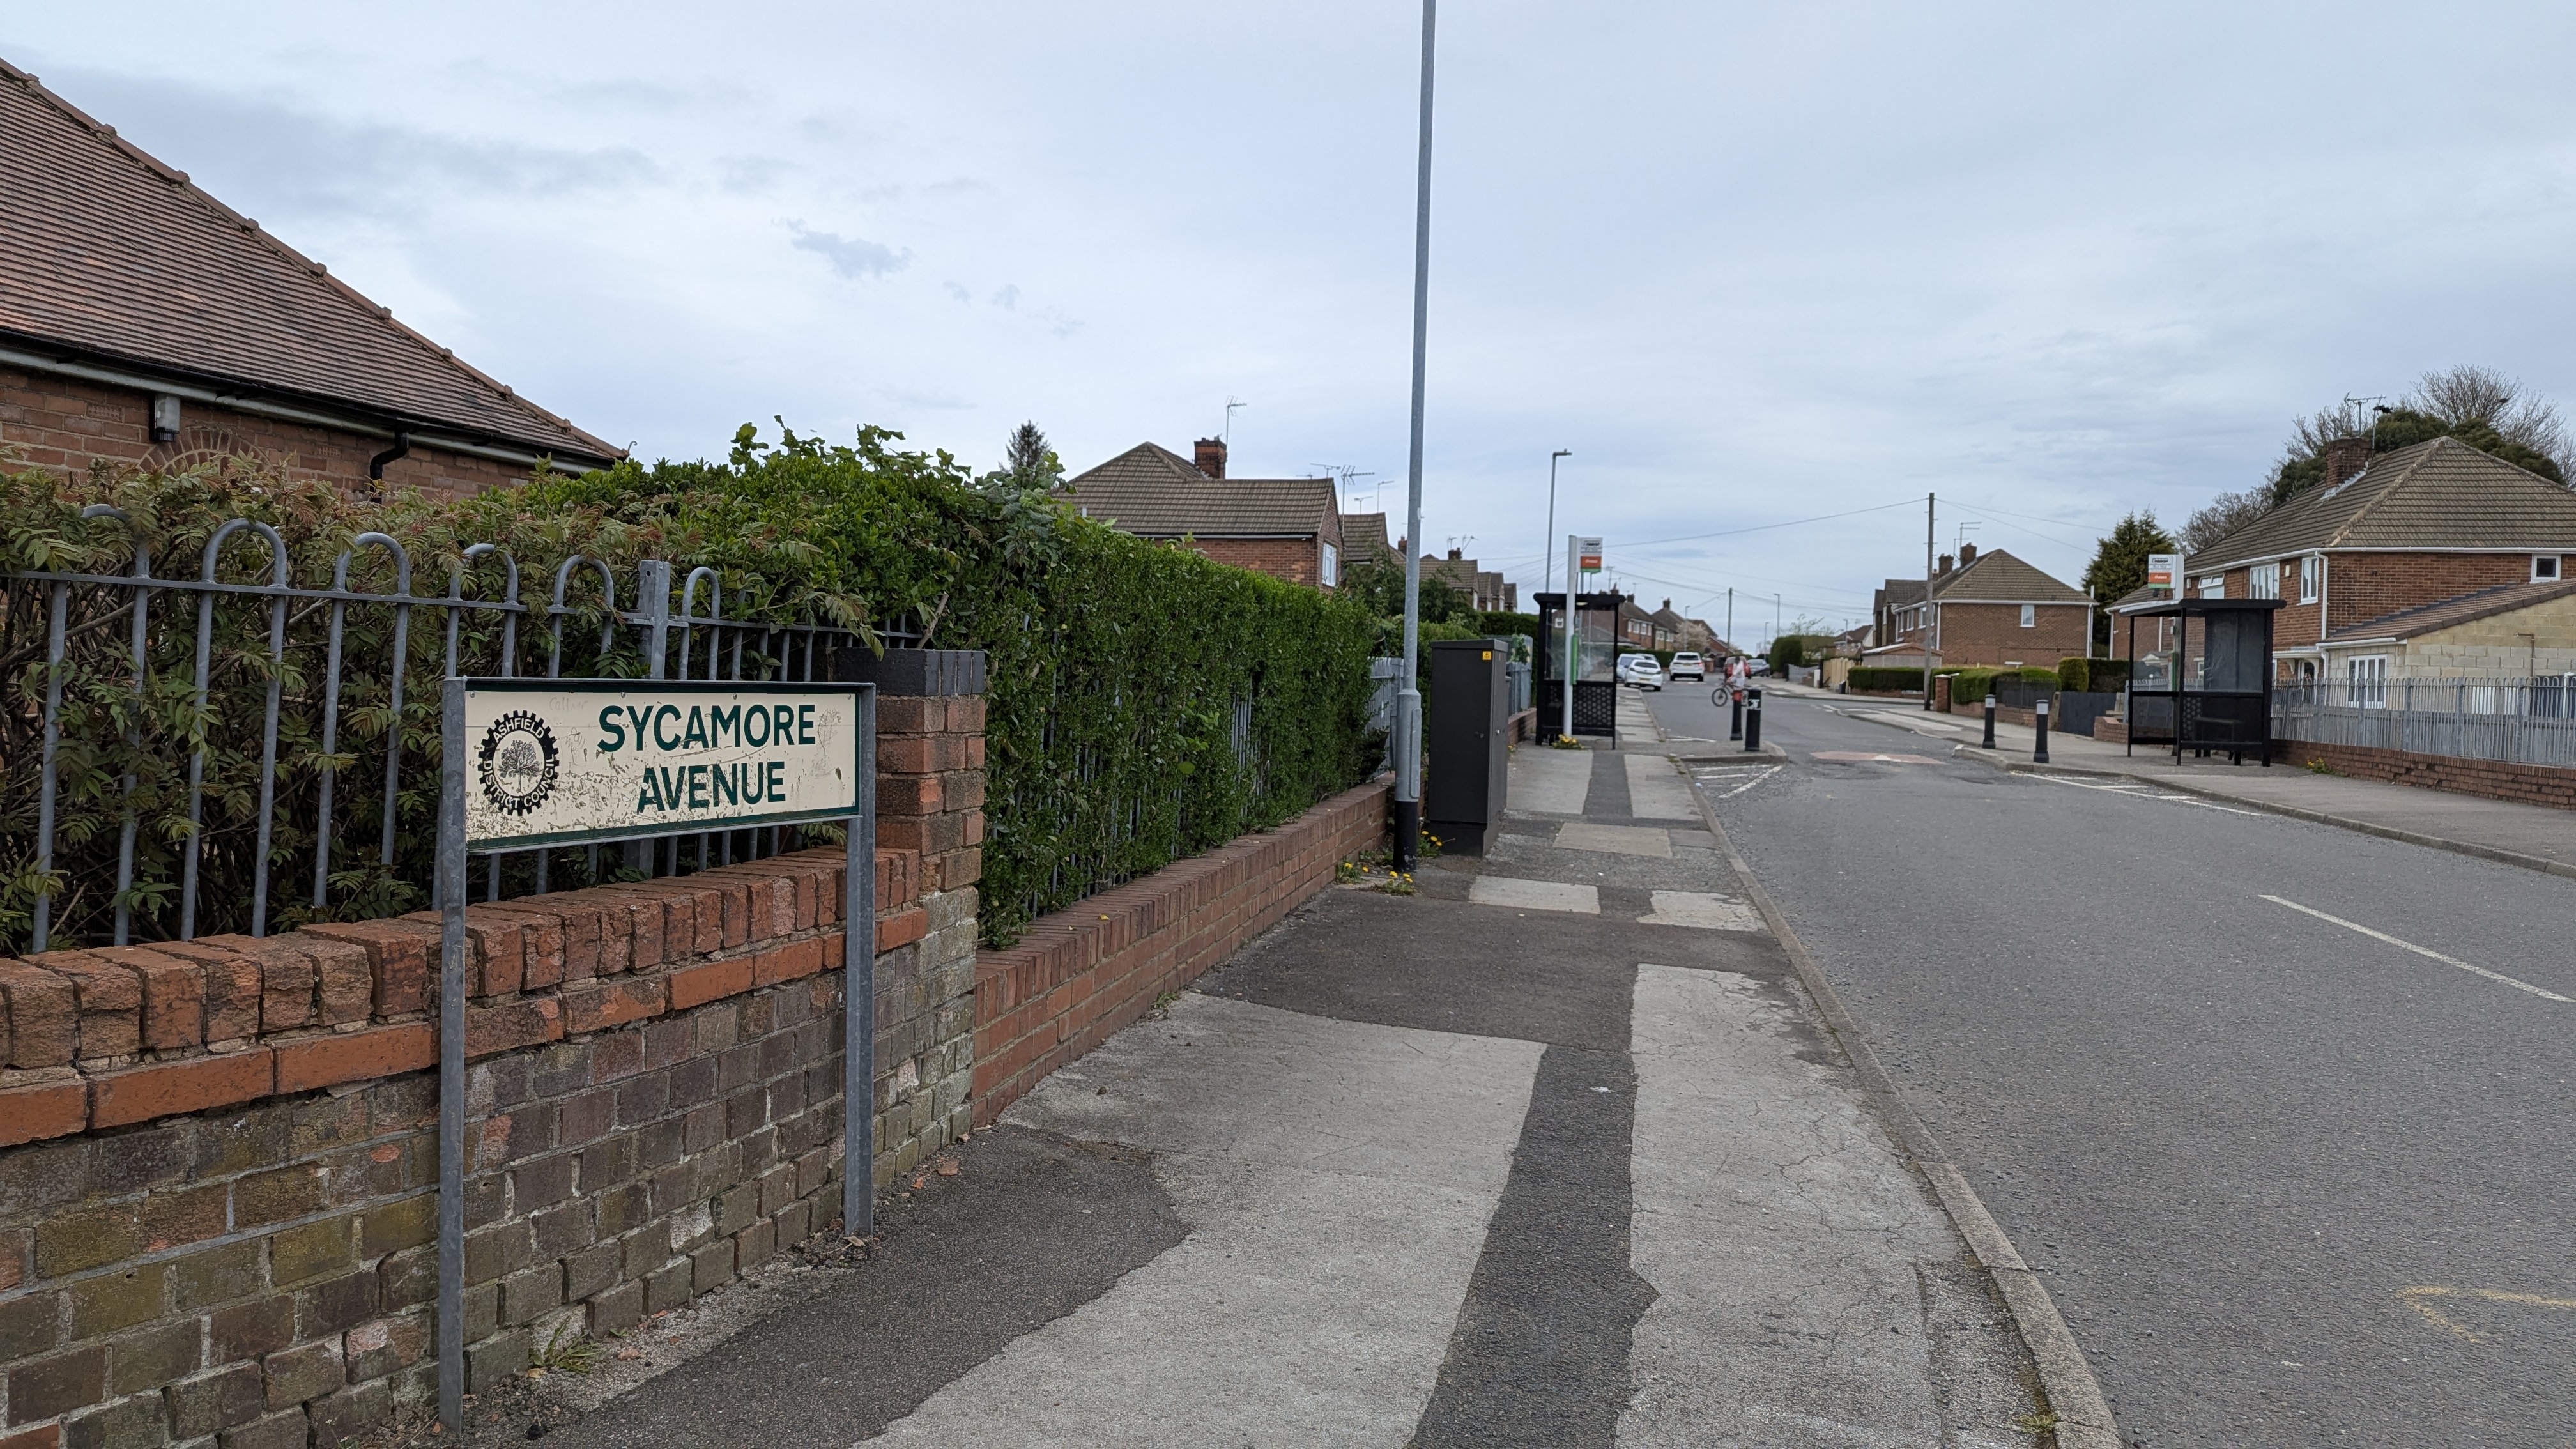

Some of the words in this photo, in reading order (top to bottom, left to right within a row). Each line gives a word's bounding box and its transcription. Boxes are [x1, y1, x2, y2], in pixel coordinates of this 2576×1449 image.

[493, 717, 544, 743] ASHFIELD
[597, 704, 816, 752] SYCAMORE
[484, 760, 521, 809] DISTRICT
[523, 753, 555, 807] COUNCIL
[637, 761, 786, 815] AVENUE
